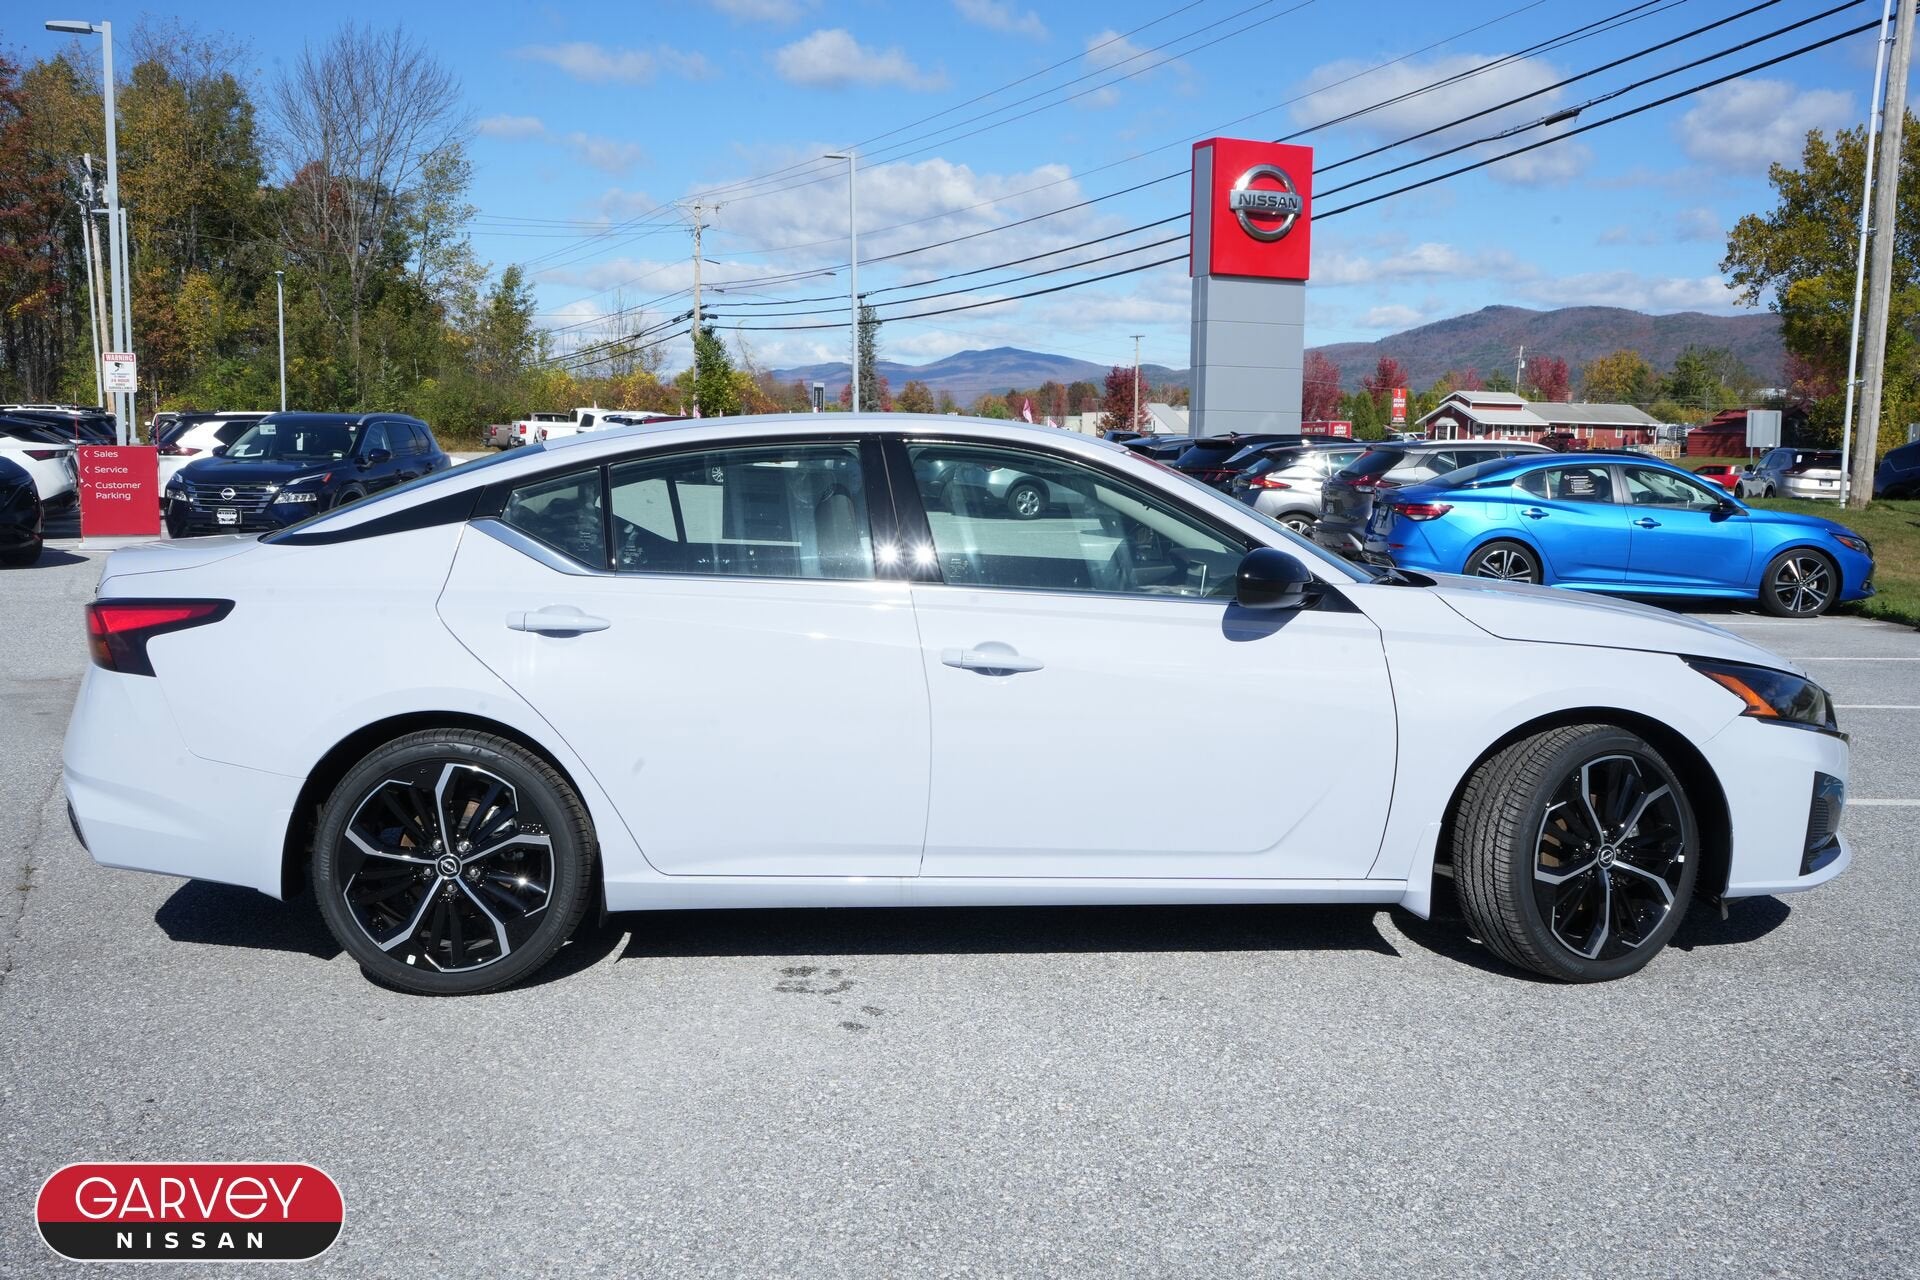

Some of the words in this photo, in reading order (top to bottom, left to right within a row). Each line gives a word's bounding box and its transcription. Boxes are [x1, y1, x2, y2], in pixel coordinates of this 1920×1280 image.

[1239, 194, 1298, 209] NISSAN
[93, 450, 119, 458] Sales
[94, 466, 129, 474] Service
[95, 481, 142, 489] Customer
[95, 492, 131, 500] Parking
